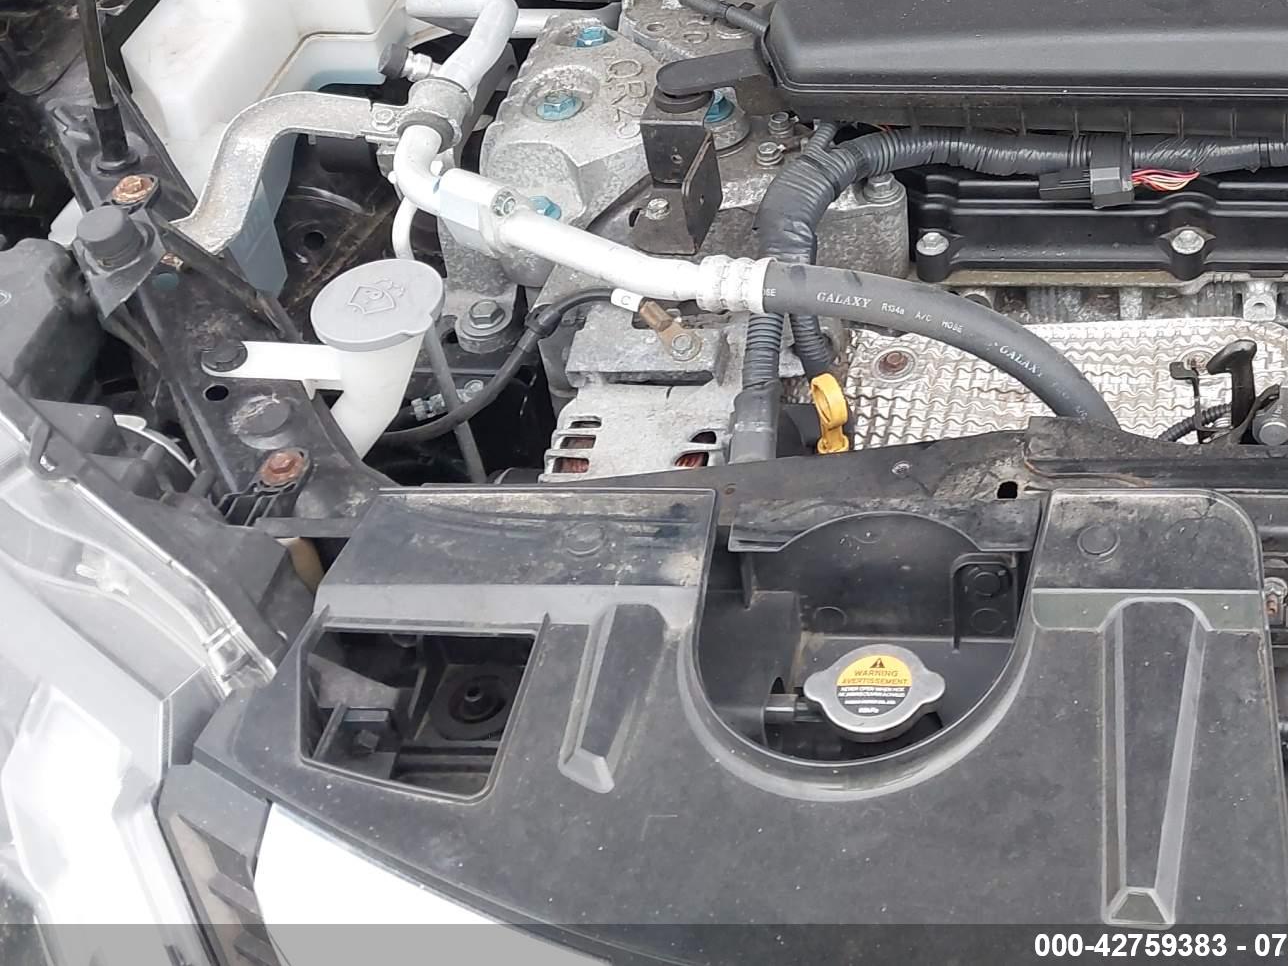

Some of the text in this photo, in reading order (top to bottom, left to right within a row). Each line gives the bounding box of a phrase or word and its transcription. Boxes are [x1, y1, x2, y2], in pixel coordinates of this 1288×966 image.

[816, 290, 873, 309] GALAXY
[914, 310, 932, 323] A/C
[941, 319, 965, 334] HOSE
[854, 670, 898, 678] WARNING
[842, 677, 908, 686] AVERTISSEMENT
